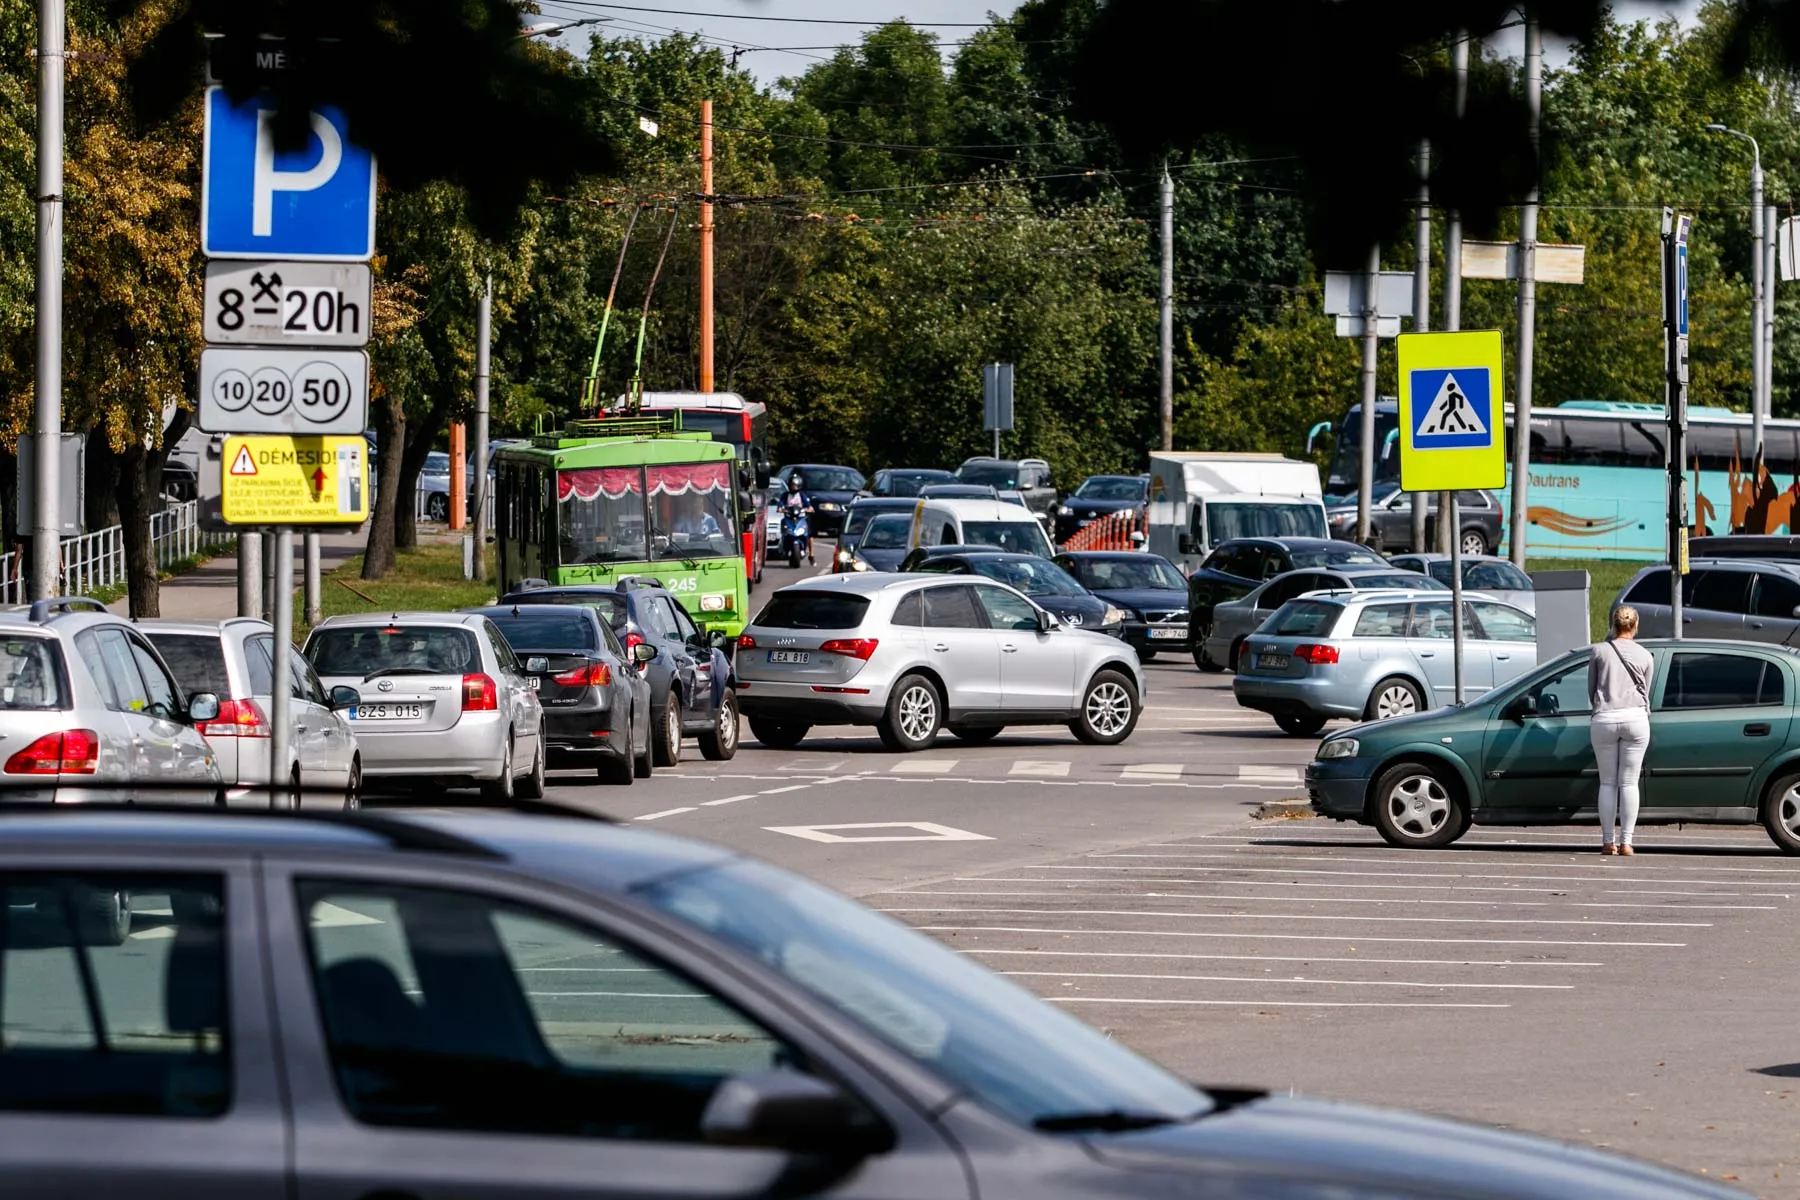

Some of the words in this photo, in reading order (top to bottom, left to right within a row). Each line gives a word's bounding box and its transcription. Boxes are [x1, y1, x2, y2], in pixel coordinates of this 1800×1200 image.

[253, 108, 342, 237] P
[220, 381, 245, 400] 10
[256, 381, 286, 402] 20
[302, 378, 341, 407] 50
[259, 448, 337, 466] DĖMESIO!
[668, 578, 697, 592] 245
[771, 652, 788, 662] LEA
[358, 705, 387, 718] GZS
[395, 705, 420, 718] 015
